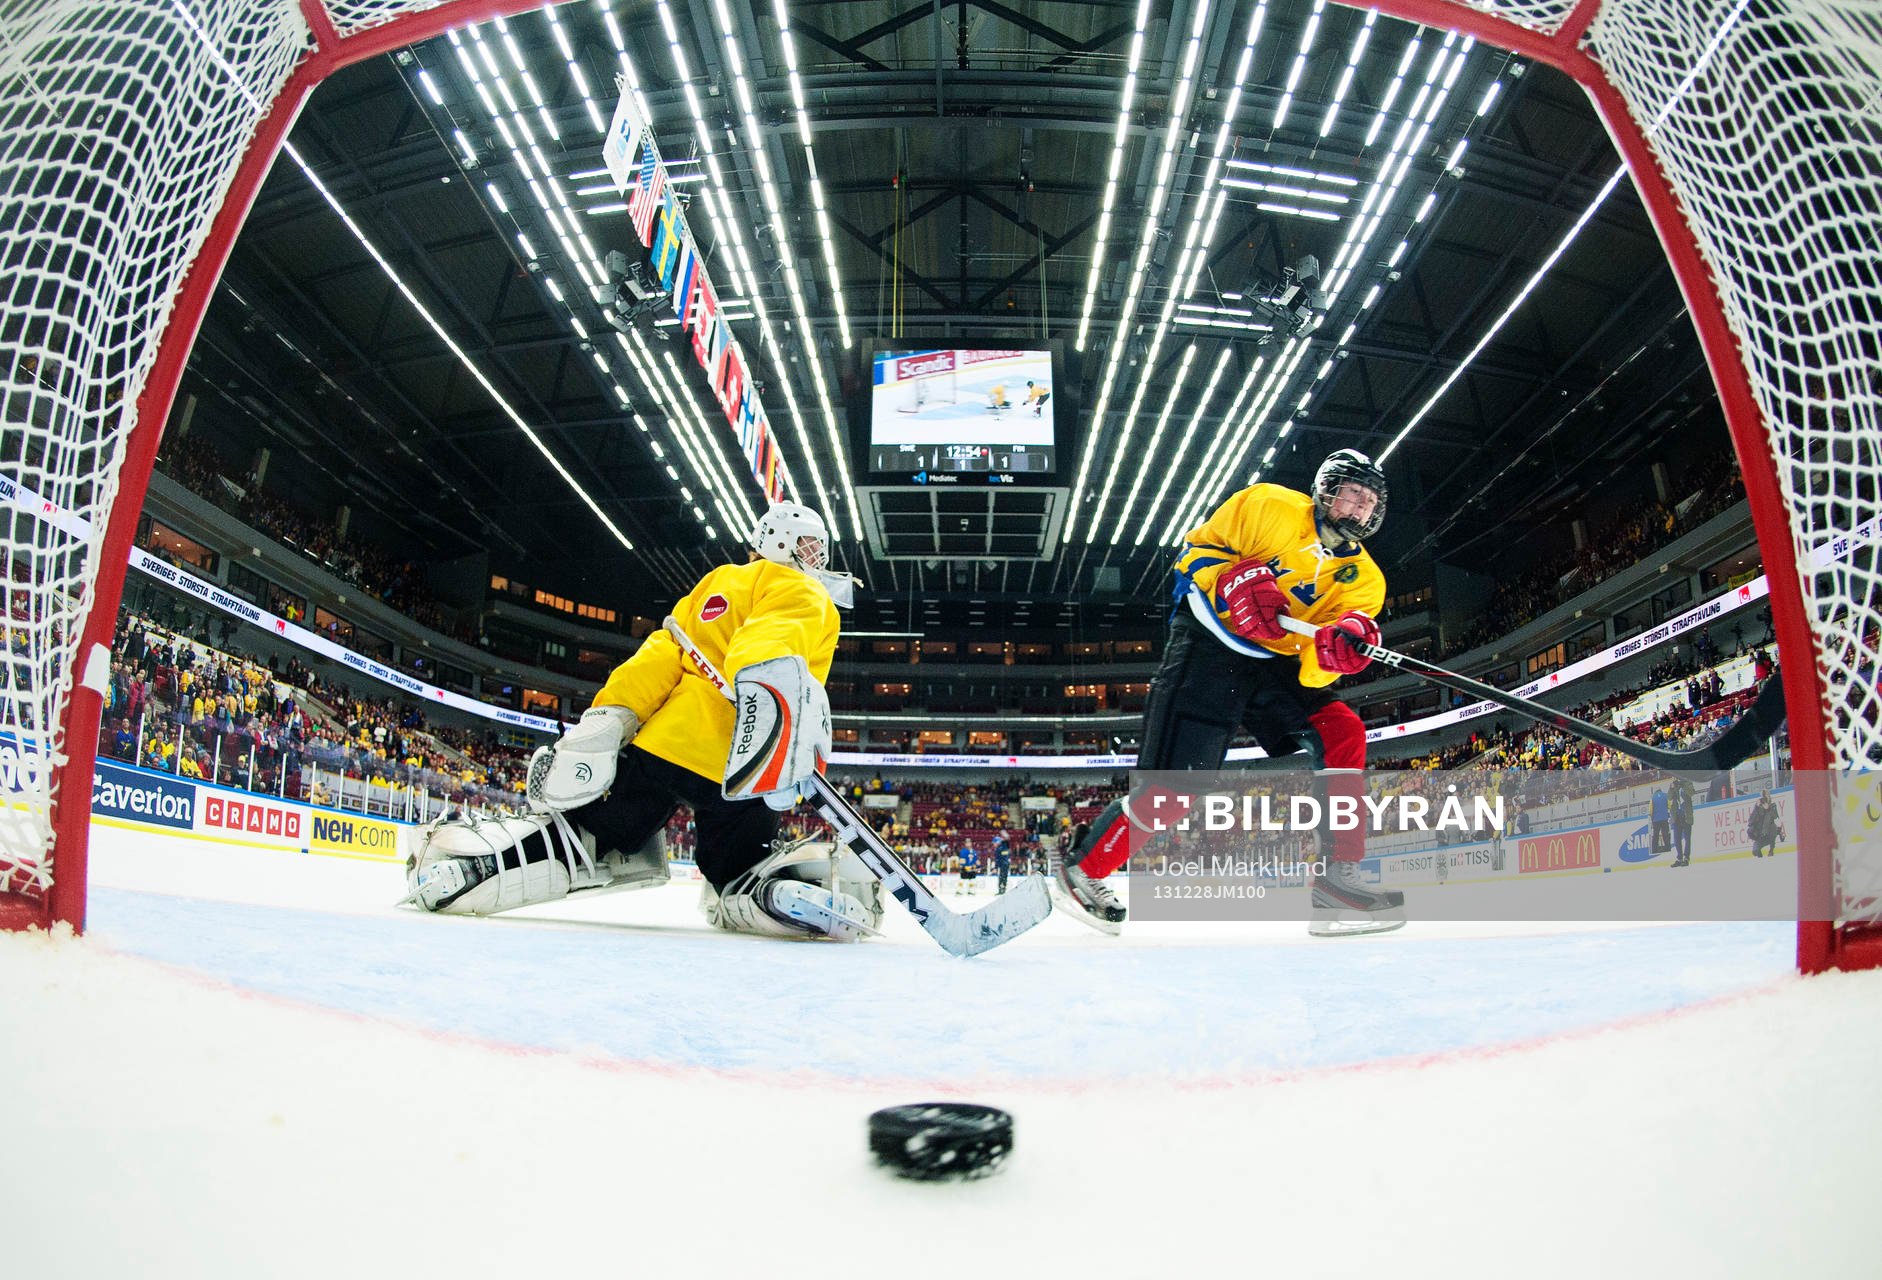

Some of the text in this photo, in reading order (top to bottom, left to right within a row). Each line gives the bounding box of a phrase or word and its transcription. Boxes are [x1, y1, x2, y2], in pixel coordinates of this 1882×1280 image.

[900, 355, 953, 378] Scandic
[946, 445, 981, 458] 12:54
[917, 455, 925, 468] 1
[959, 459, 966, 470] 1
[1001, 455, 1008, 468] 1
[141, 557, 177, 582] SVERIGES
[1223, 566, 1274, 599] EAST
[1614, 639, 1642, 659] SVERIGES
[736, 692, 758, 755] Reebok
[208, 802, 297, 834] CRAMO
[1714, 811, 1731, 828] WE
[1714, 830, 1736, 848] FOR
[1401, 856, 1433, 872] TISSOT
